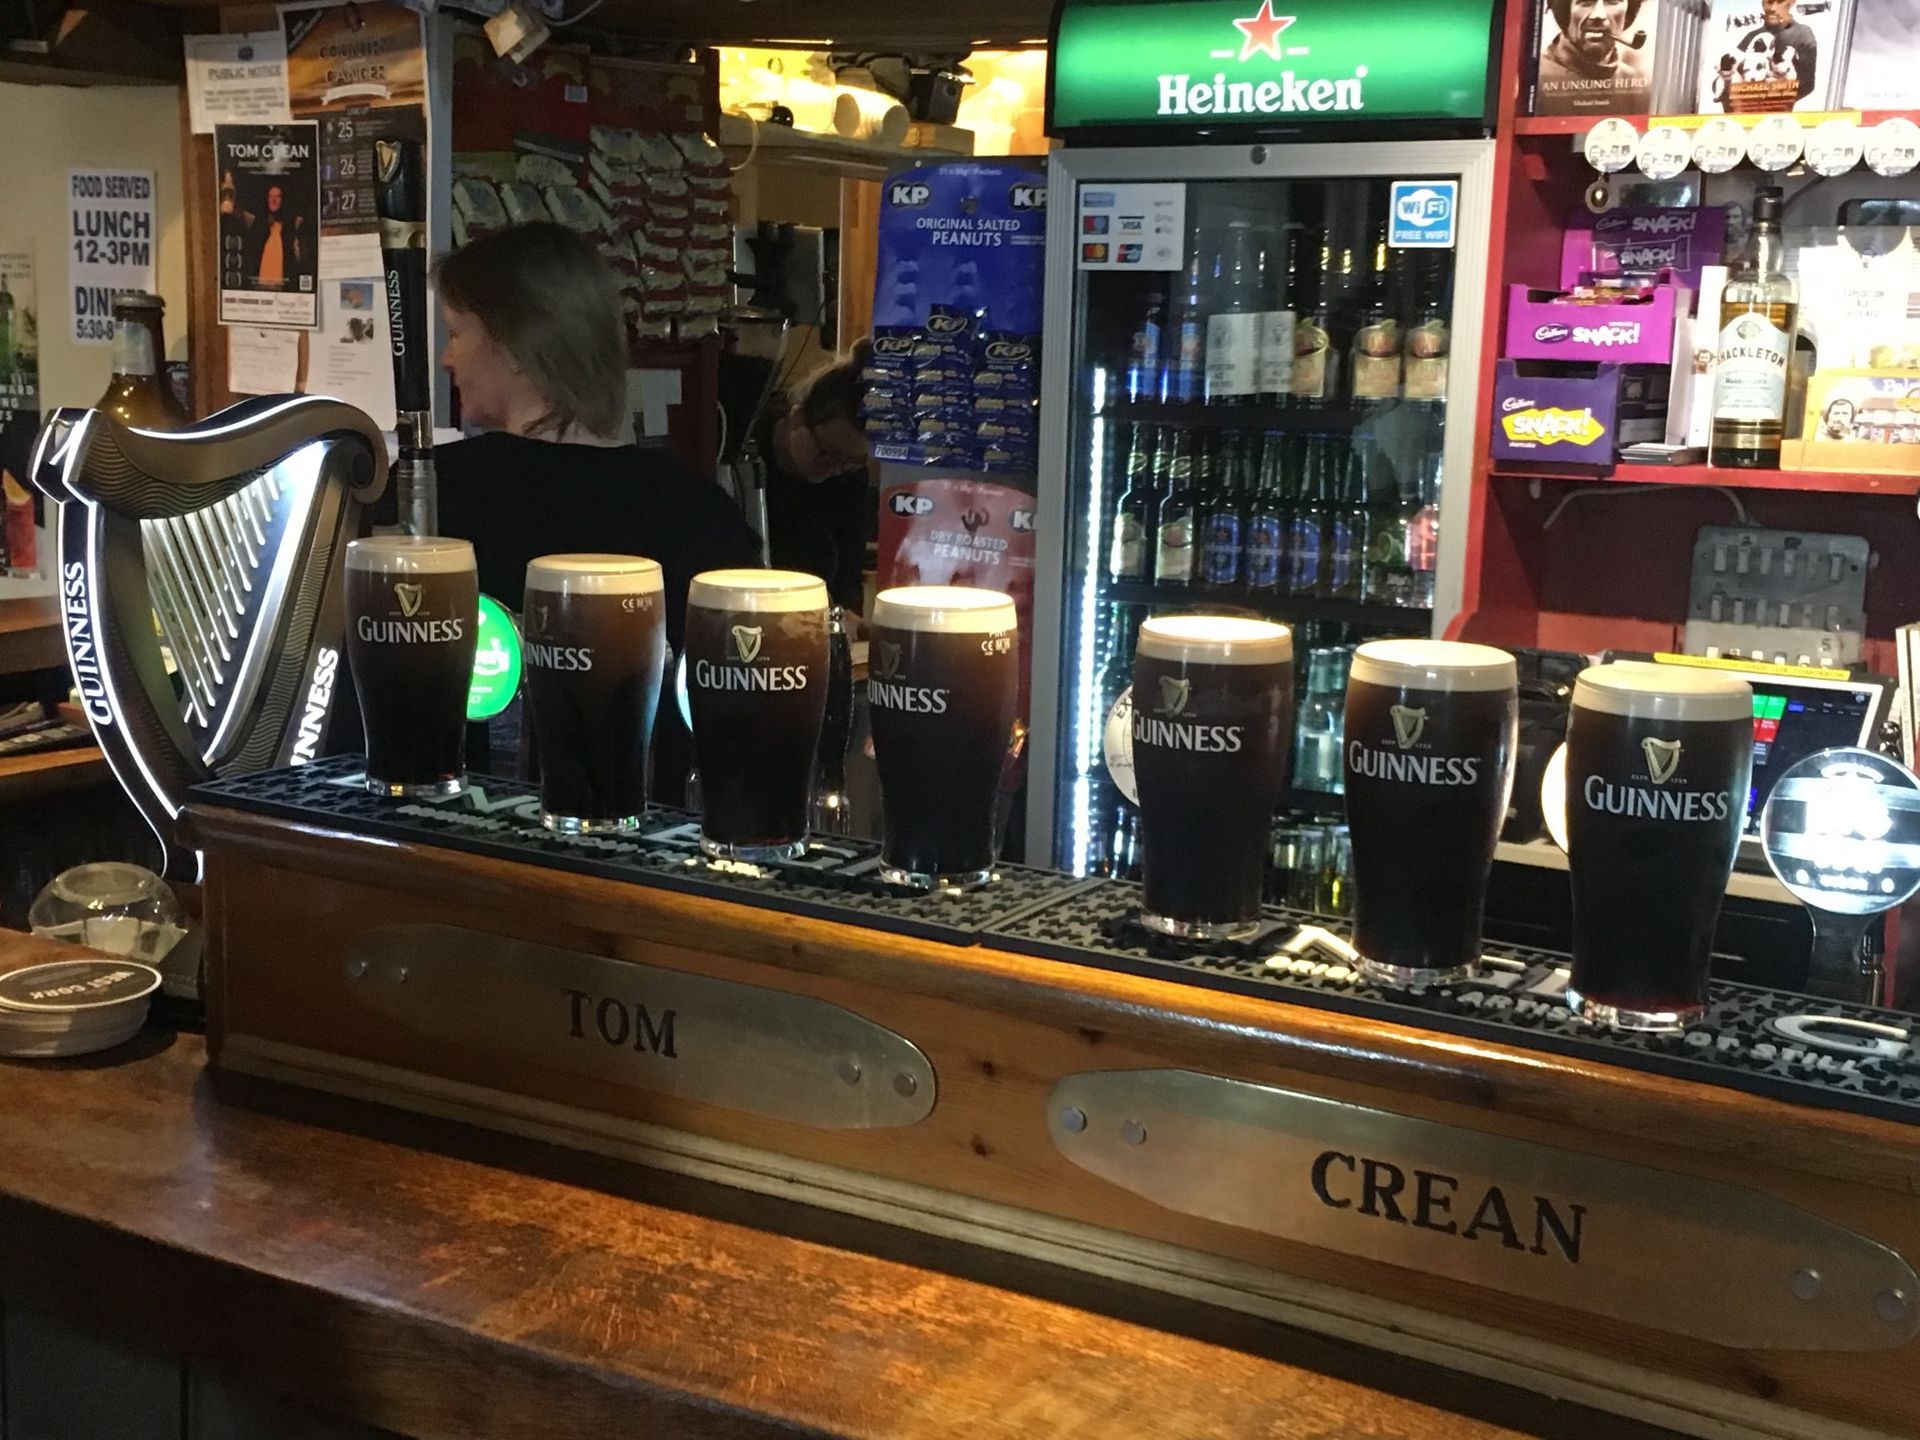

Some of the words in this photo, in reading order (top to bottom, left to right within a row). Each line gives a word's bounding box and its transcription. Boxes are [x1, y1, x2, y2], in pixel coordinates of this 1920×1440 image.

[208, 67, 245, 80] PUBLIC
[247, 65, 282, 78] NOTICE
[326, 65, 385, 83] CANCER
[1543, 82, 1559, 91] AN
[1562, 79, 1612, 90] UNSUNG
[1615, 78, 1648, 89] HERO
[1157, 70, 1365, 115] Heineken
[338, 121, 354, 138] 25
[228, 144, 259, 158] TOM
[340, 158, 356, 176] 26
[72, 175, 102, 198] FOOD
[105, 176, 150, 199] SERVED
[892, 186, 930, 204] KP
[341, 194, 356, 211] 27
[73, 210, 150, 239] LUNCH
[917, 217, 973, 230] ORIGINAL
[977, 219, 1021, 231] SALTED
[1121, 220, 1142, 230] VISA
[1395, 230, 1422, 240] FREE
[1424, 230, 1449, 240] WIFI
[932, 231, 1002, 247] PEANUTS
[74, 240, 150, 266] 12-3PM
[387, 270, 406, 356] GUINNESS
[1572, 322, 1640, 347] SNACK!
[1513, 407, 1592, 439] SNACK!
[895, 495, 934, 515] KP
[1013, 511, 1037, 530] K
[931, 529, 952, 541] DRY
[956, 532, 1009, 550] ROASTED
[934, 544, 1001, 565] PEANUTS
[357, 615, 463, 643] GUINNESS
[64, 561, 113, 726] GUINNESS
[696, 659, 807, 691] GUINNESS
[290, 648, 339, 767] INNESS
[867, 679, 947, 714] UINNESS
[1132, 709, 1243, 753] GUINNESS
[1349, 740, 1480, 786] GUINNESS
[1584, 774, 1728, 821] GUINNESS
[30, 984, 86, 999] CORK
[565, 988, 679, 1060] TOM
[1750, 1043, 1861, 1076] STILL
[1311, 1149, 1589, 1265] CREAN
